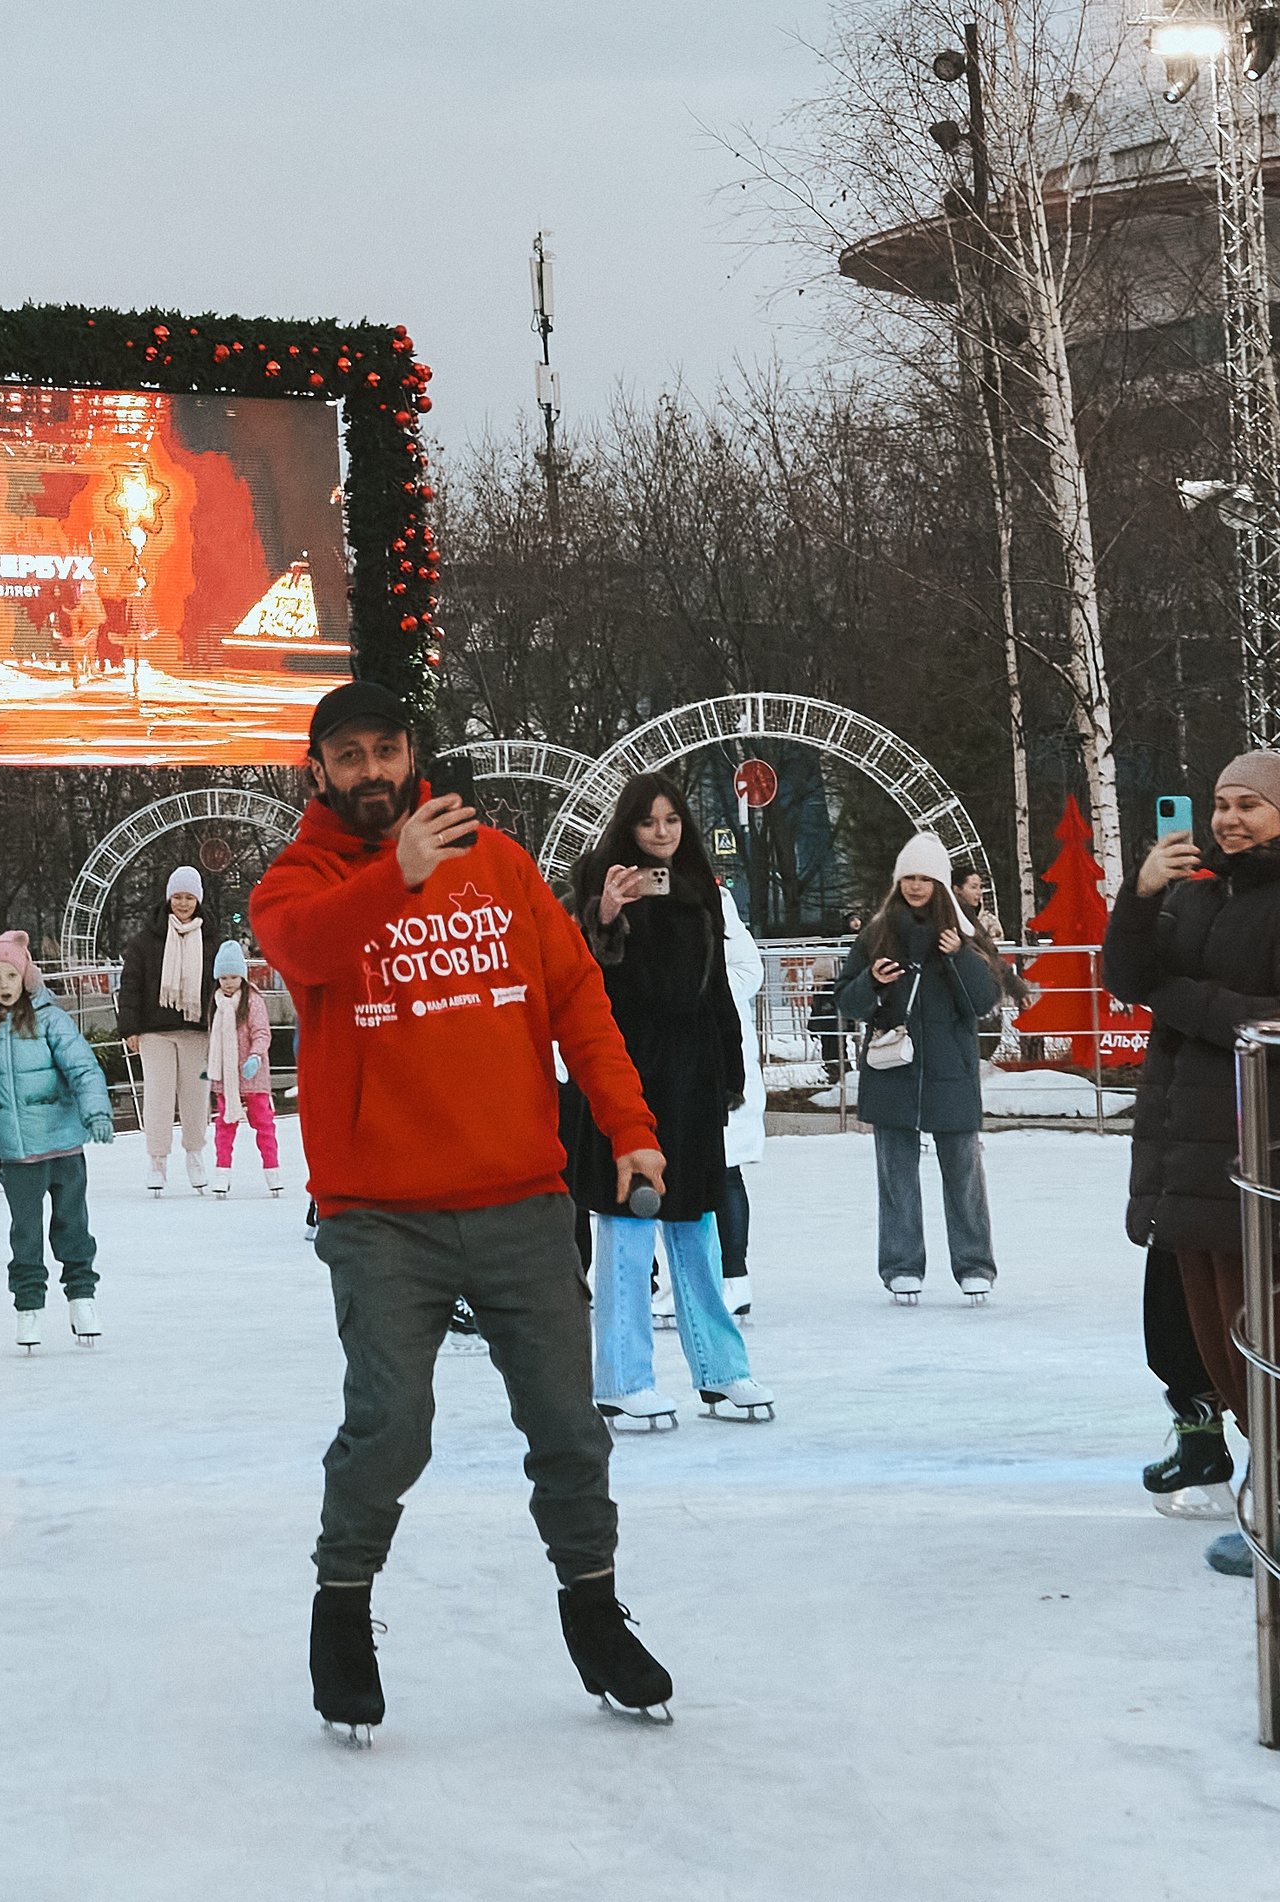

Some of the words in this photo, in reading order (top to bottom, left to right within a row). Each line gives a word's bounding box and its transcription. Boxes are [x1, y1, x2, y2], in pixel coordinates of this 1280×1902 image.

[385, 906, 513, 948] ХОЛОДУ
[381, 941, 510, 986] ГОТОВЫ!
[354, 1003, 396, 1014] winter
[355, 1014, 381, 1027] fest
